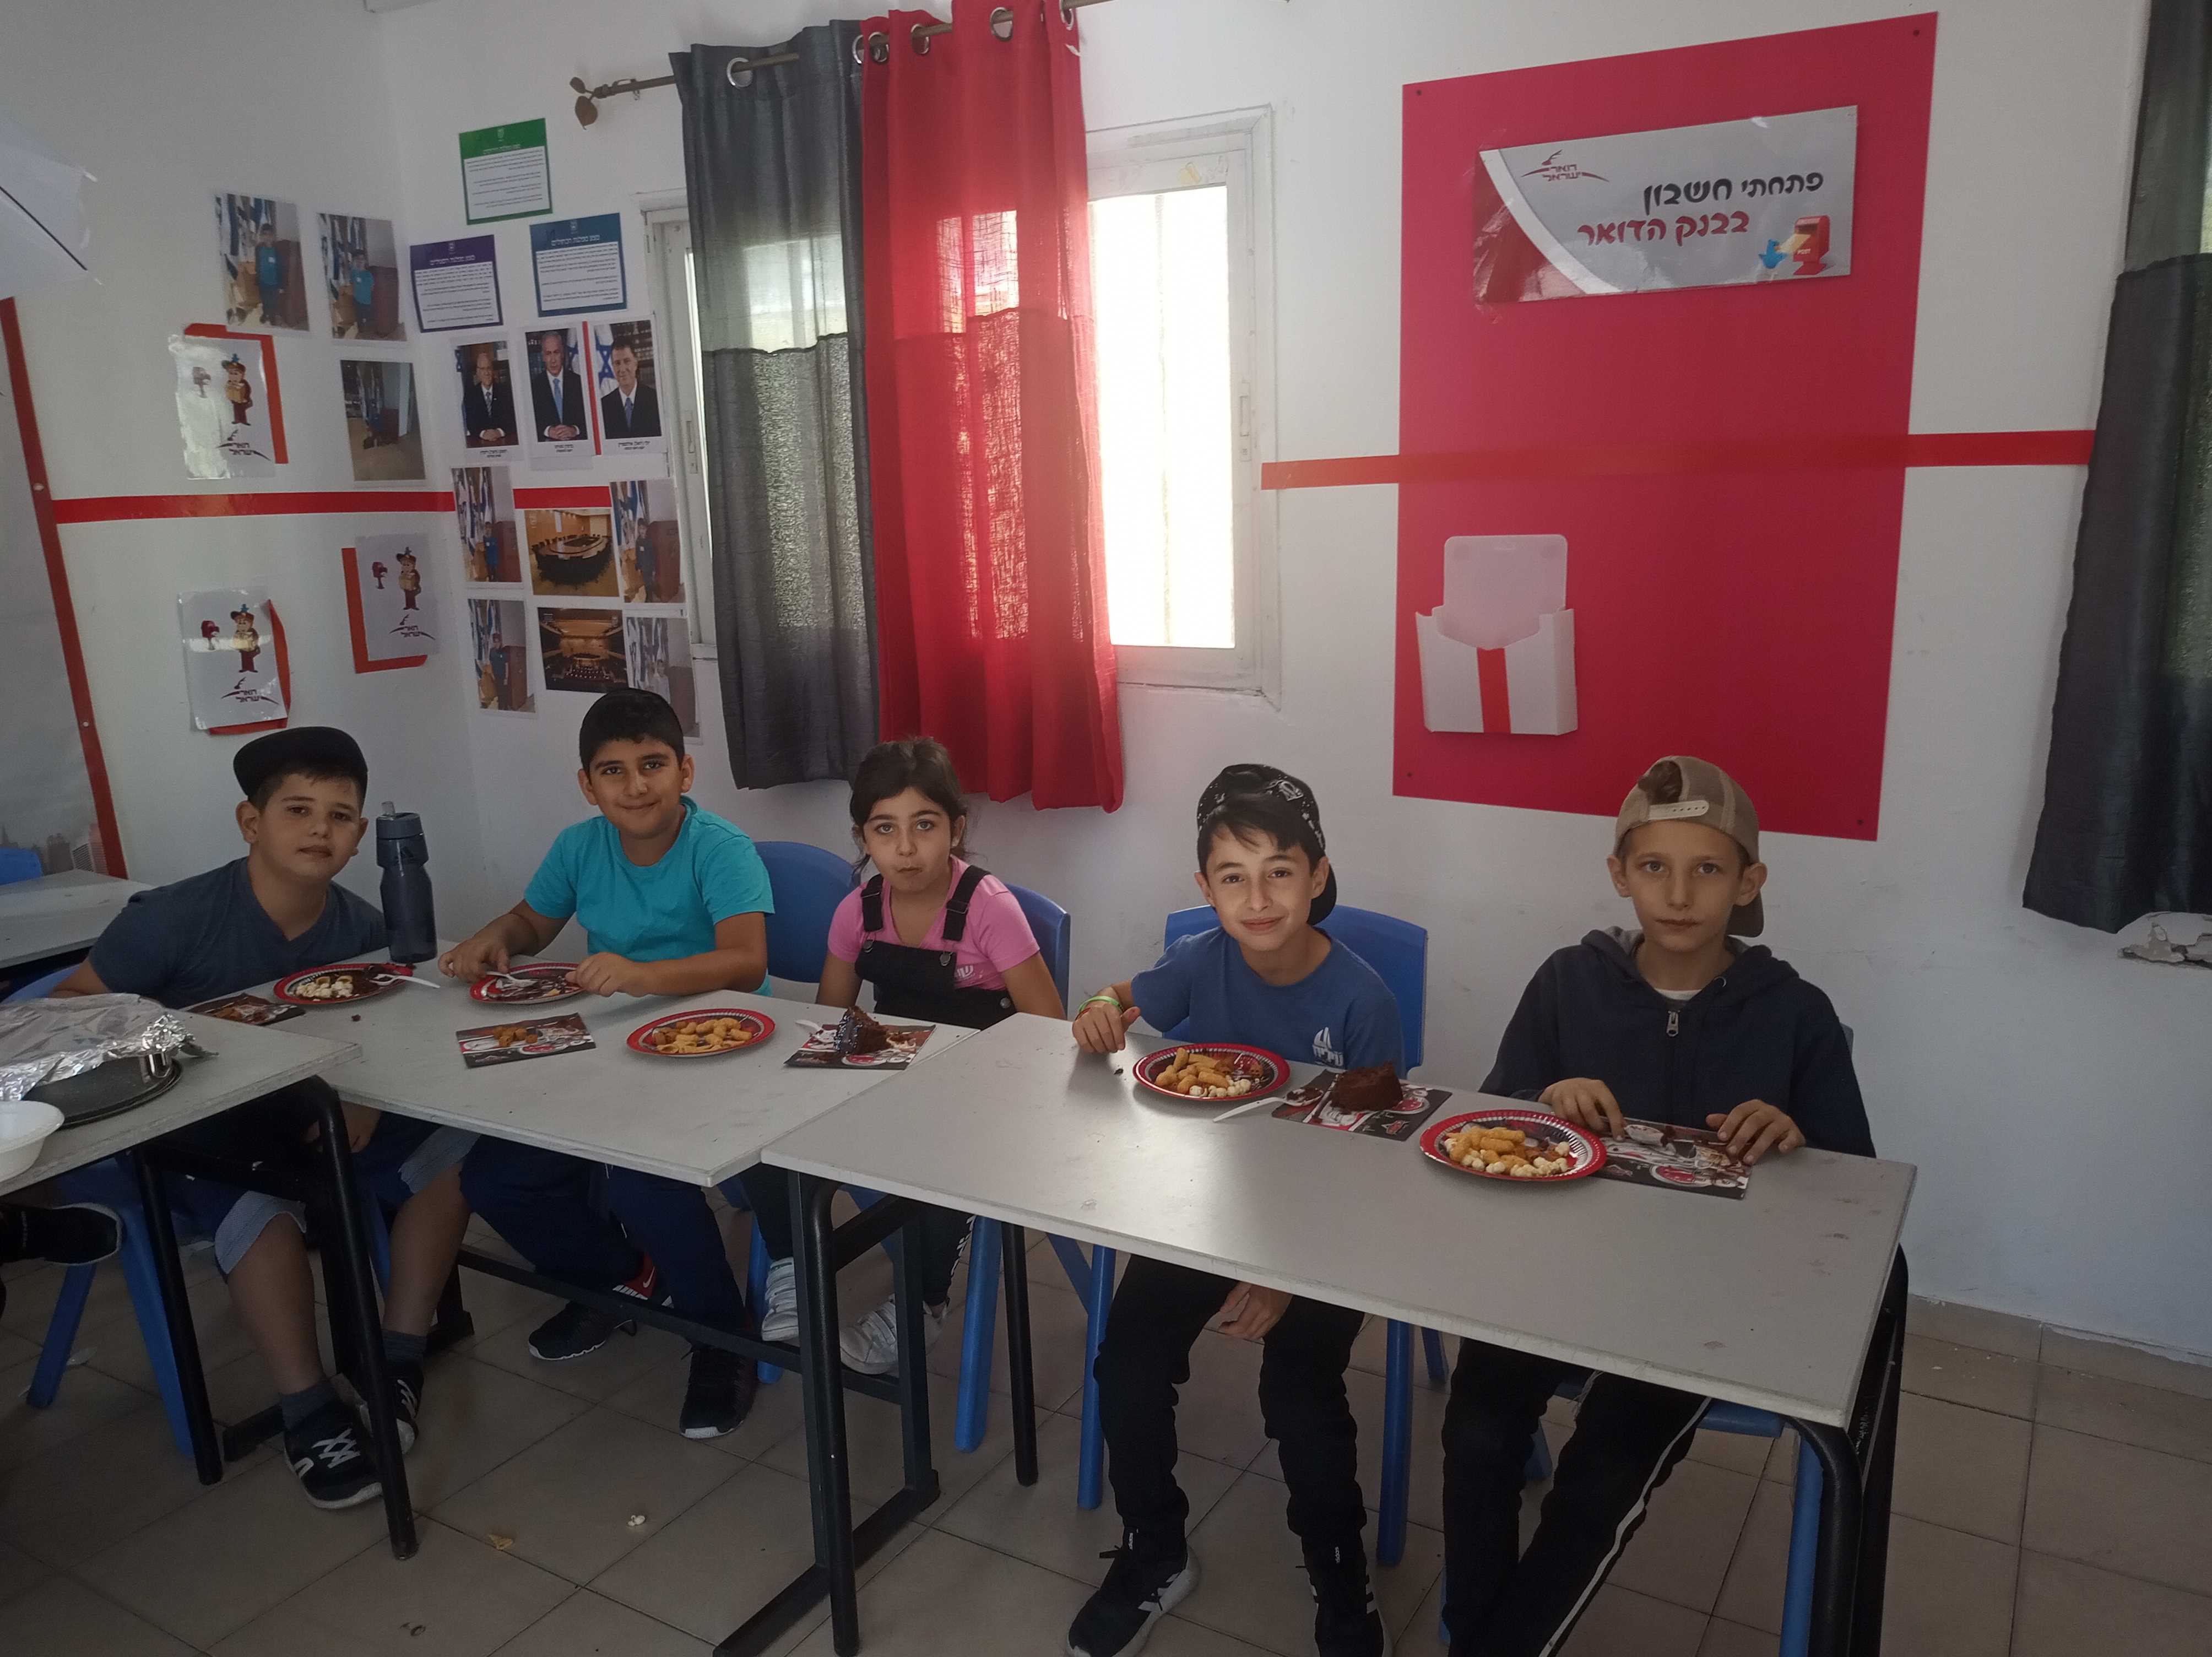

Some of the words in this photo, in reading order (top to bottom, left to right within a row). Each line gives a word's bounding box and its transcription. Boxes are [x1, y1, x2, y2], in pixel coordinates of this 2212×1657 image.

[1542, 172, 1581, 182] ישראל
[1550, 164, 1577, 172] דואר
[1644, 178, 1733, 216] חשבון
[1741, 172, 1824, 198] פתחתי
[1577, 218, 1667, 246] הדואר
[1675, 210, 1750, 247] בבנק
